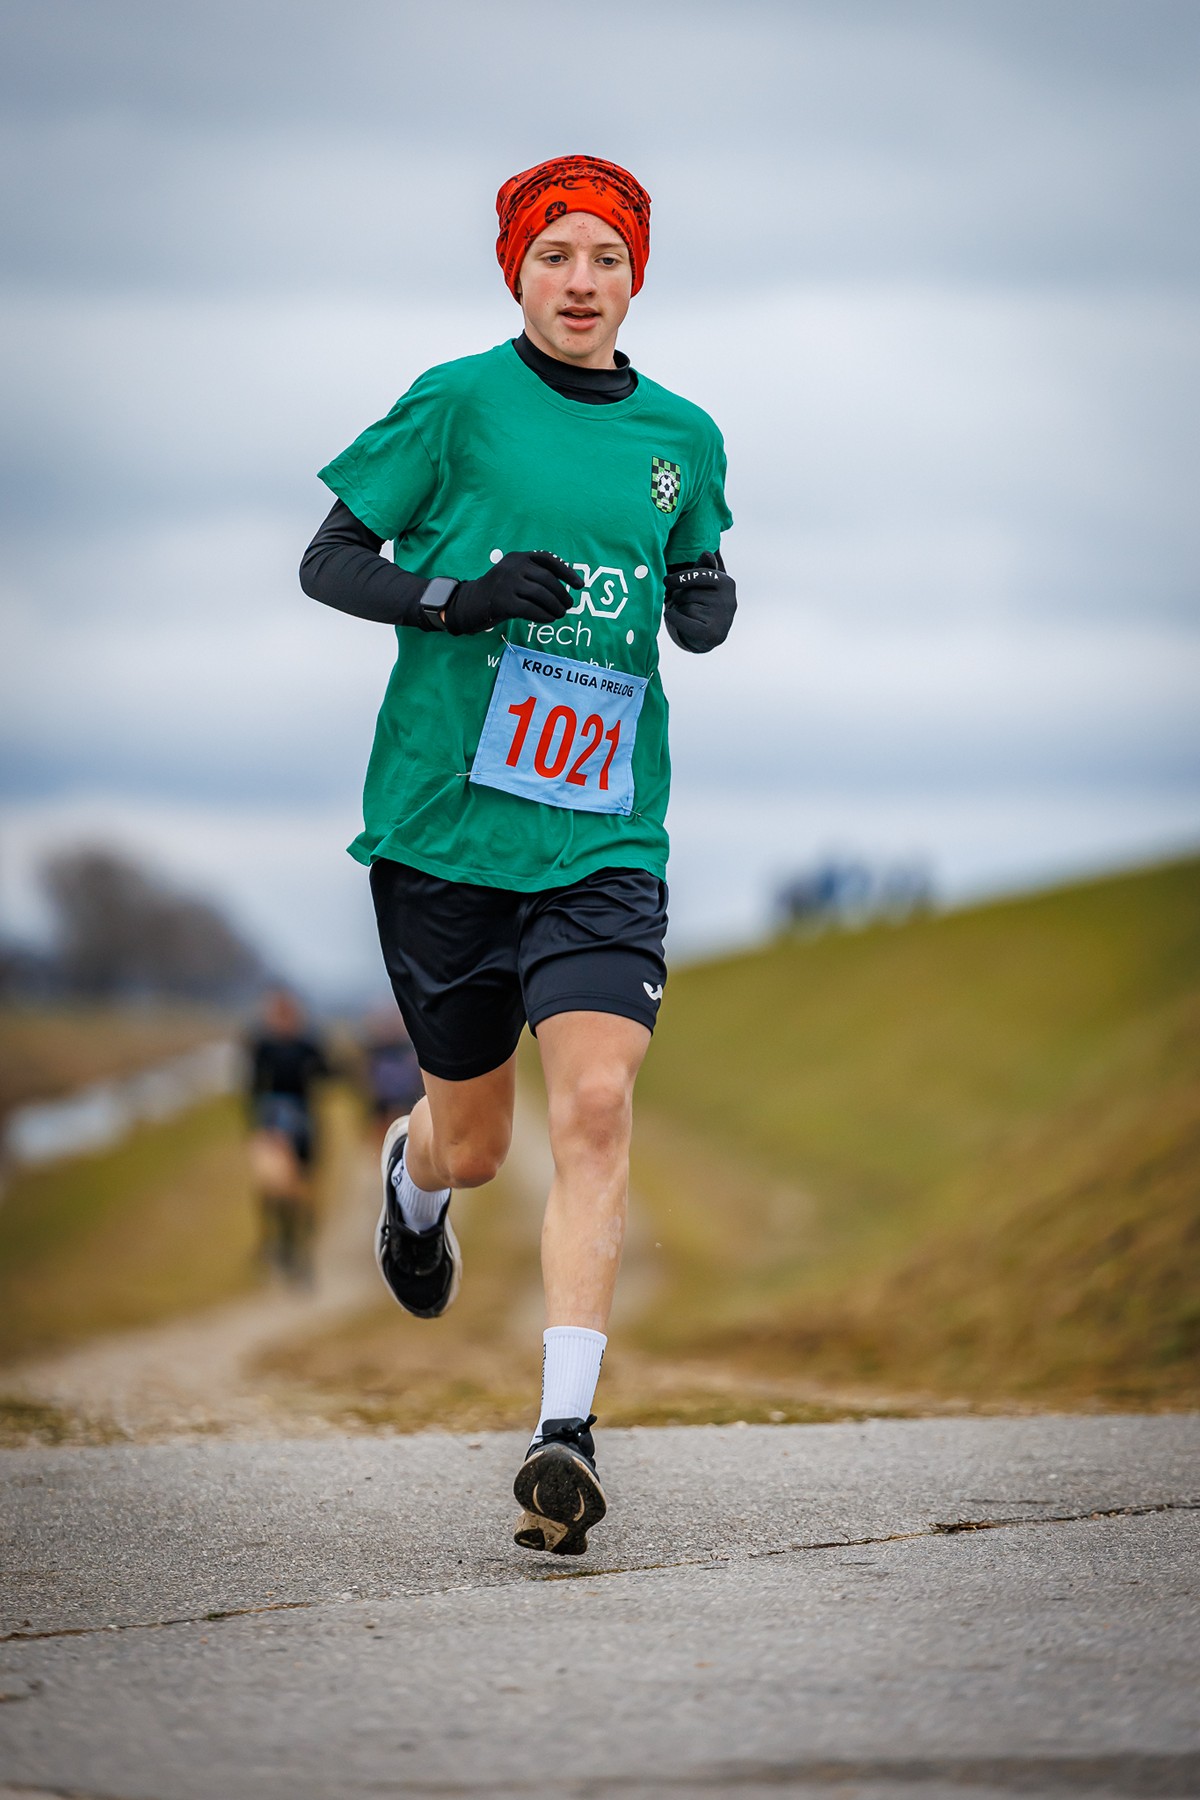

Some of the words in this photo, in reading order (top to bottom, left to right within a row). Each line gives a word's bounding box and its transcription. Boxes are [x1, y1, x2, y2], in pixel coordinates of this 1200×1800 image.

[527, 620, 592, 647] tech
[522, 658, 563, 680] KROS
[566, 670, 598, 689] LIGA
[600, 679, 635, 698] PRELOG
[505, 695, 621, 791] 1021
